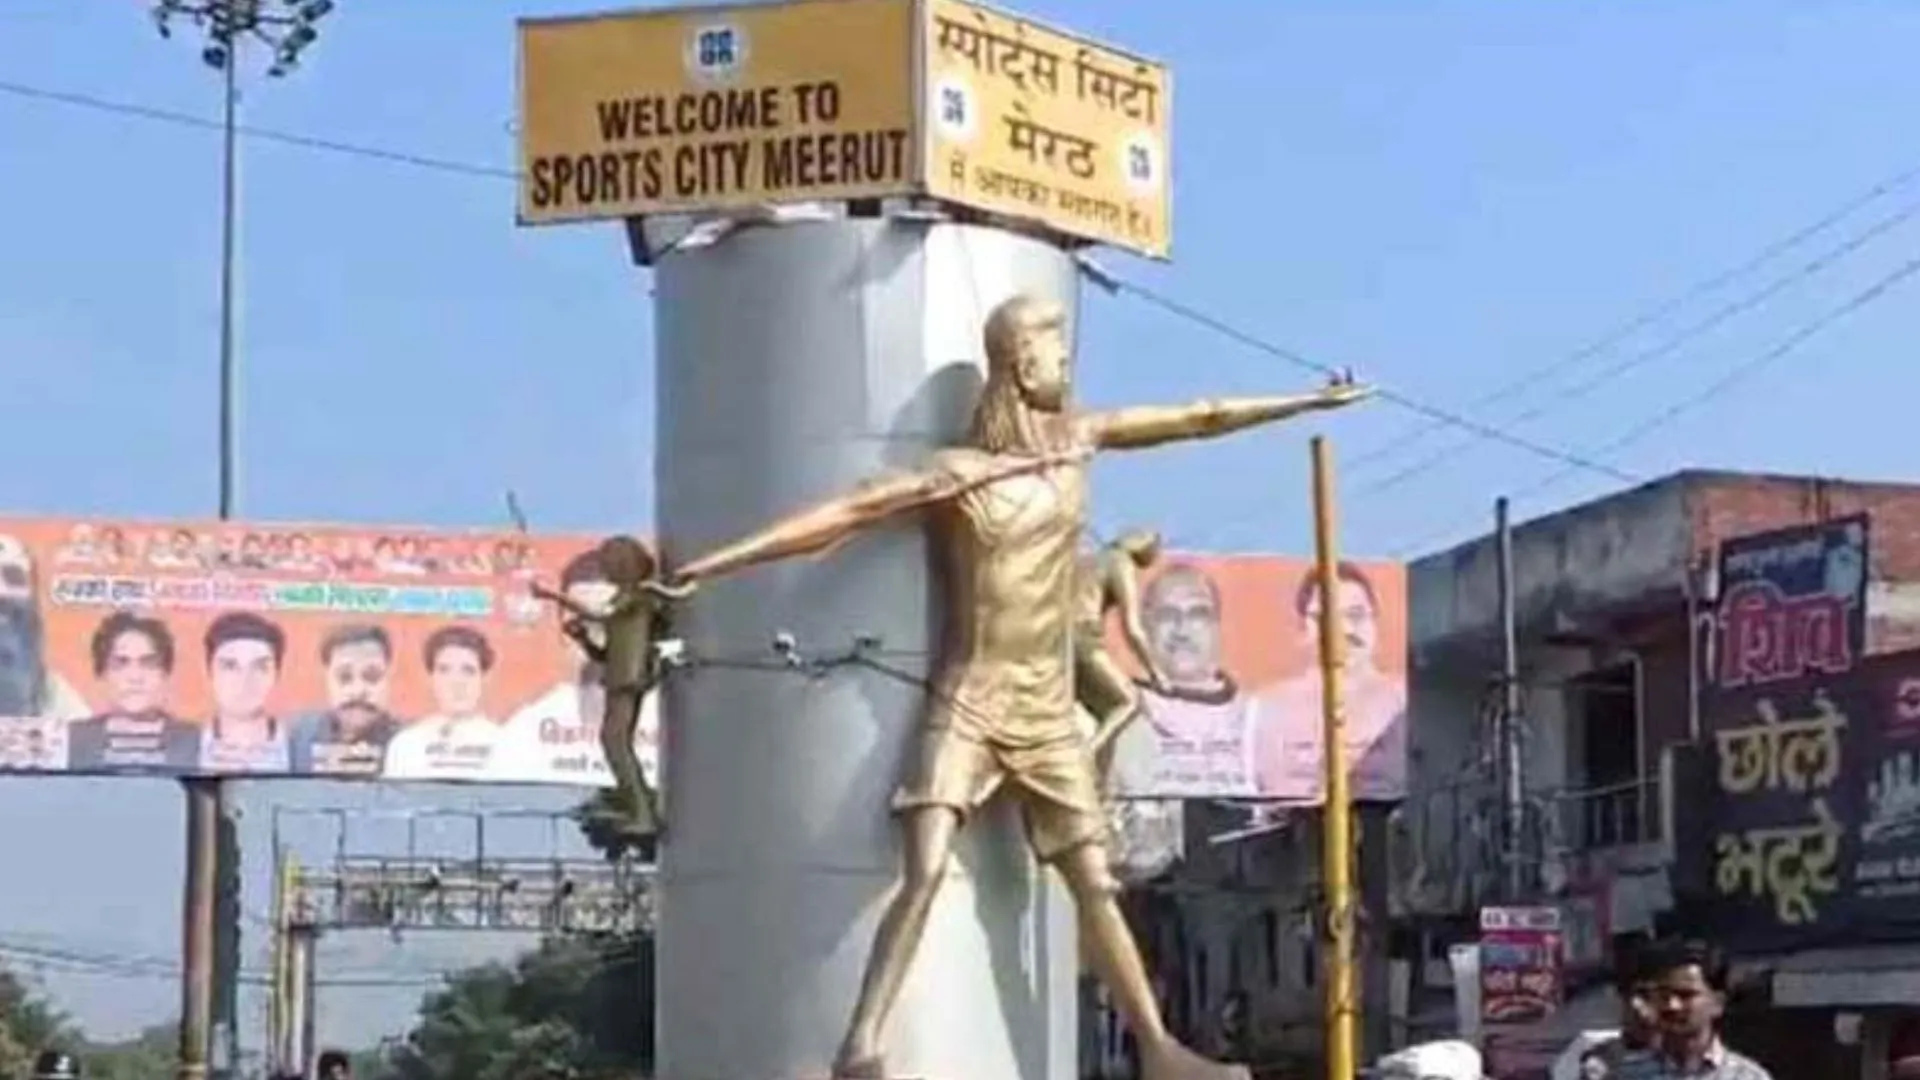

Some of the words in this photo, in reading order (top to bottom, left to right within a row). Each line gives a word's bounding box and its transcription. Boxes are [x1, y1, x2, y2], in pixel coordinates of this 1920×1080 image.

[597, 86, 781, 141] WELCOME
[793, 82, 840, 122] TO
[1072, 48, 1158, 124] सिटी
[531, 147, 663, 208] SPORTS
[673, 139, 750, 196] CITY
[762, 130, 908, 190] MEERUT
[1002, 101, 1100, 179] मेरठ
[1715, 688, 1849, 793] छोले
[1716, 798, 1845, 923] भटूरे
